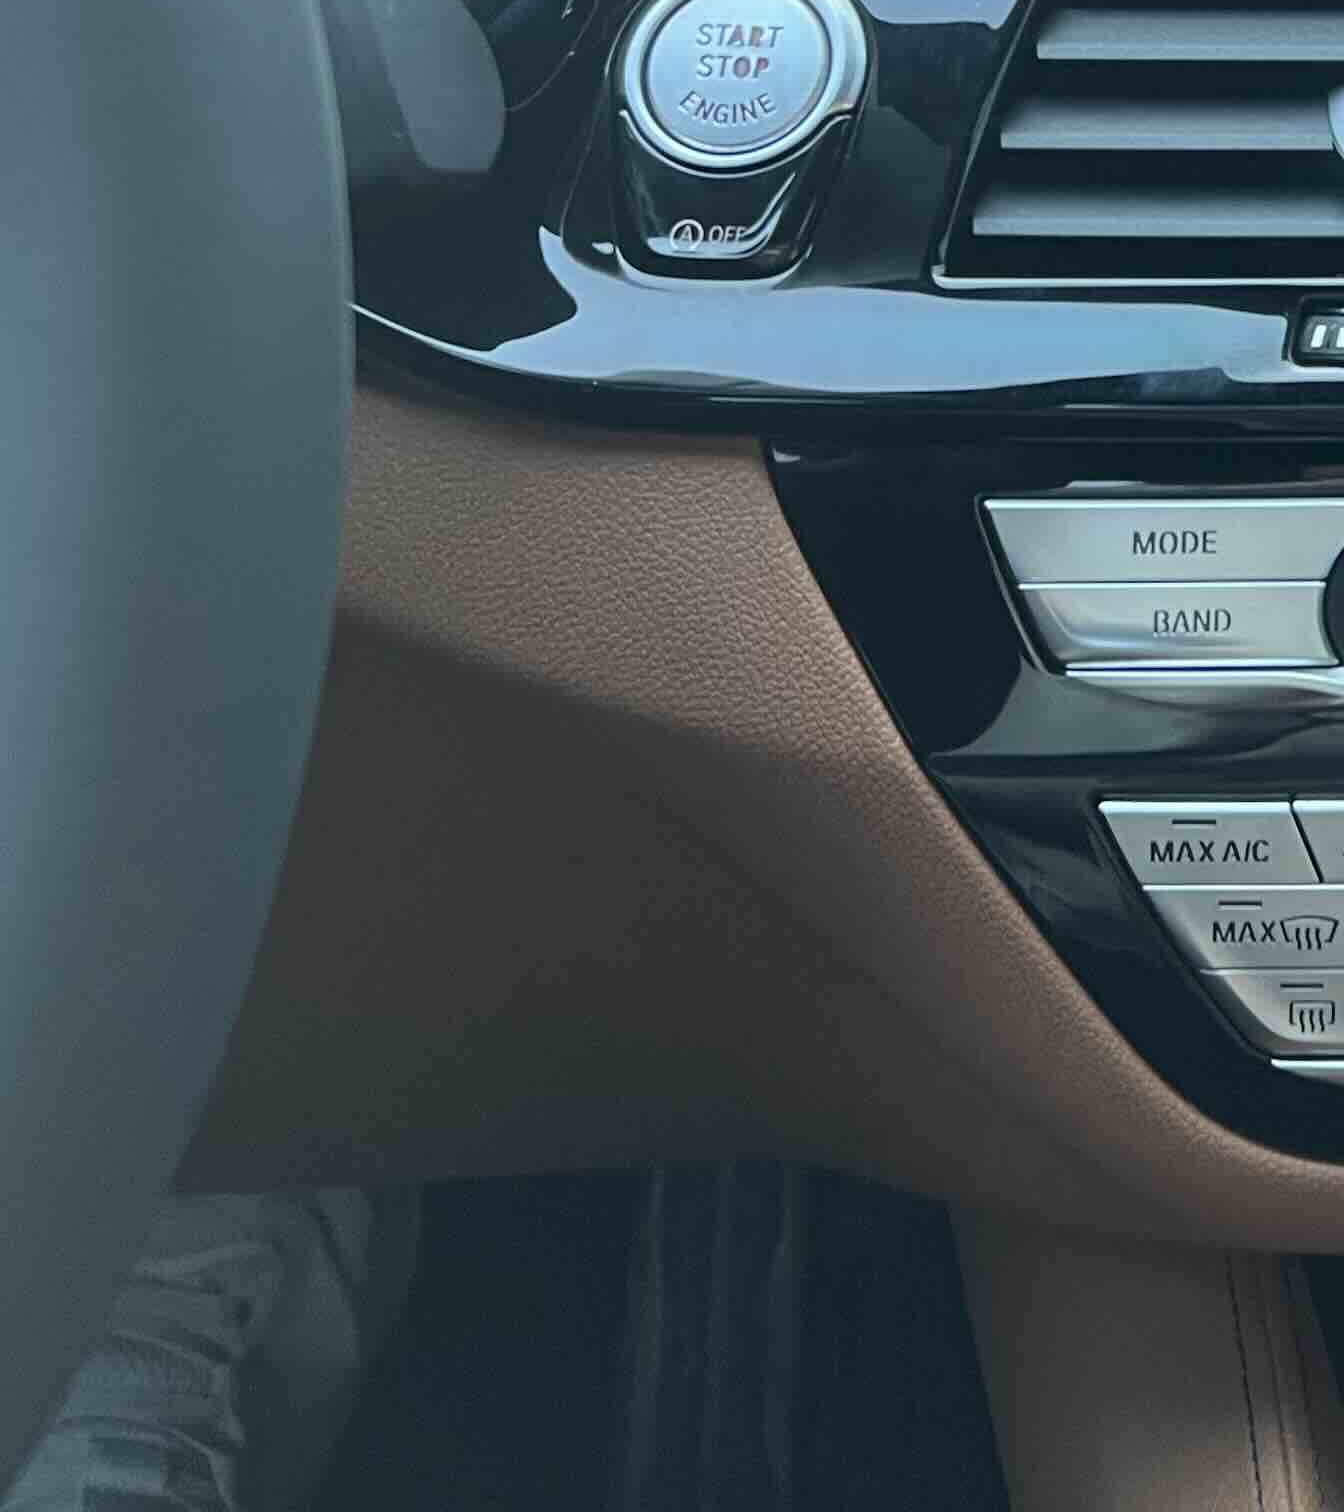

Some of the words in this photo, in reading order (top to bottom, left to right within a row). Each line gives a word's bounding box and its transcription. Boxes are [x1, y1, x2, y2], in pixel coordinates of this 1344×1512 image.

[695, 23, 785, 49] START
[695, 54, 770, 80] STOP
[678, 89, 778, 126] ENGINE
[708, 225, 748, 243] OFF
[1131, 529, 1218, 556] MODE
[1151, 608, 1233, 634] BAND
[1149, 839, 1214, 864] MAX
[1222, 838, 1270, 864] A/C
[1211, 920, 1277, 944] MAX
